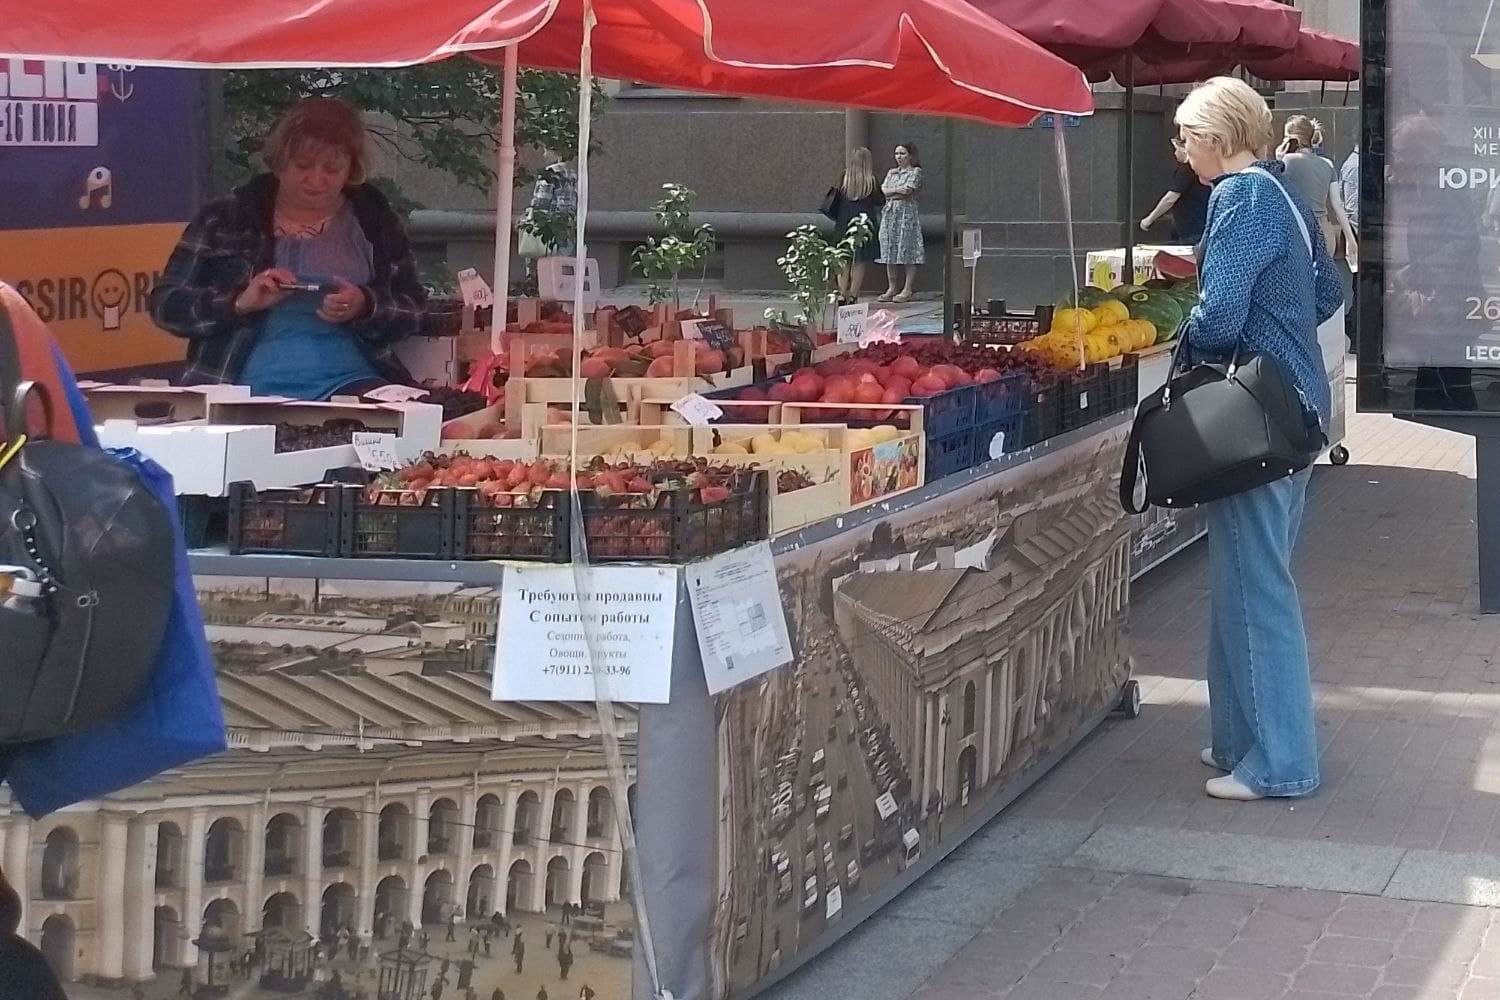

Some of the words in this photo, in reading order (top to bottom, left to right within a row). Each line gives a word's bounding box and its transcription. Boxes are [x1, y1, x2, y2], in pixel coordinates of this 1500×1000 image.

[1473, 127, 1493, 140] XII
[596, 591, 662, 605] продавцы
[529, 610, 541, 623] С
[601, 611, 650, 626] работы
[542, 664, 581, 676] +7(911)
